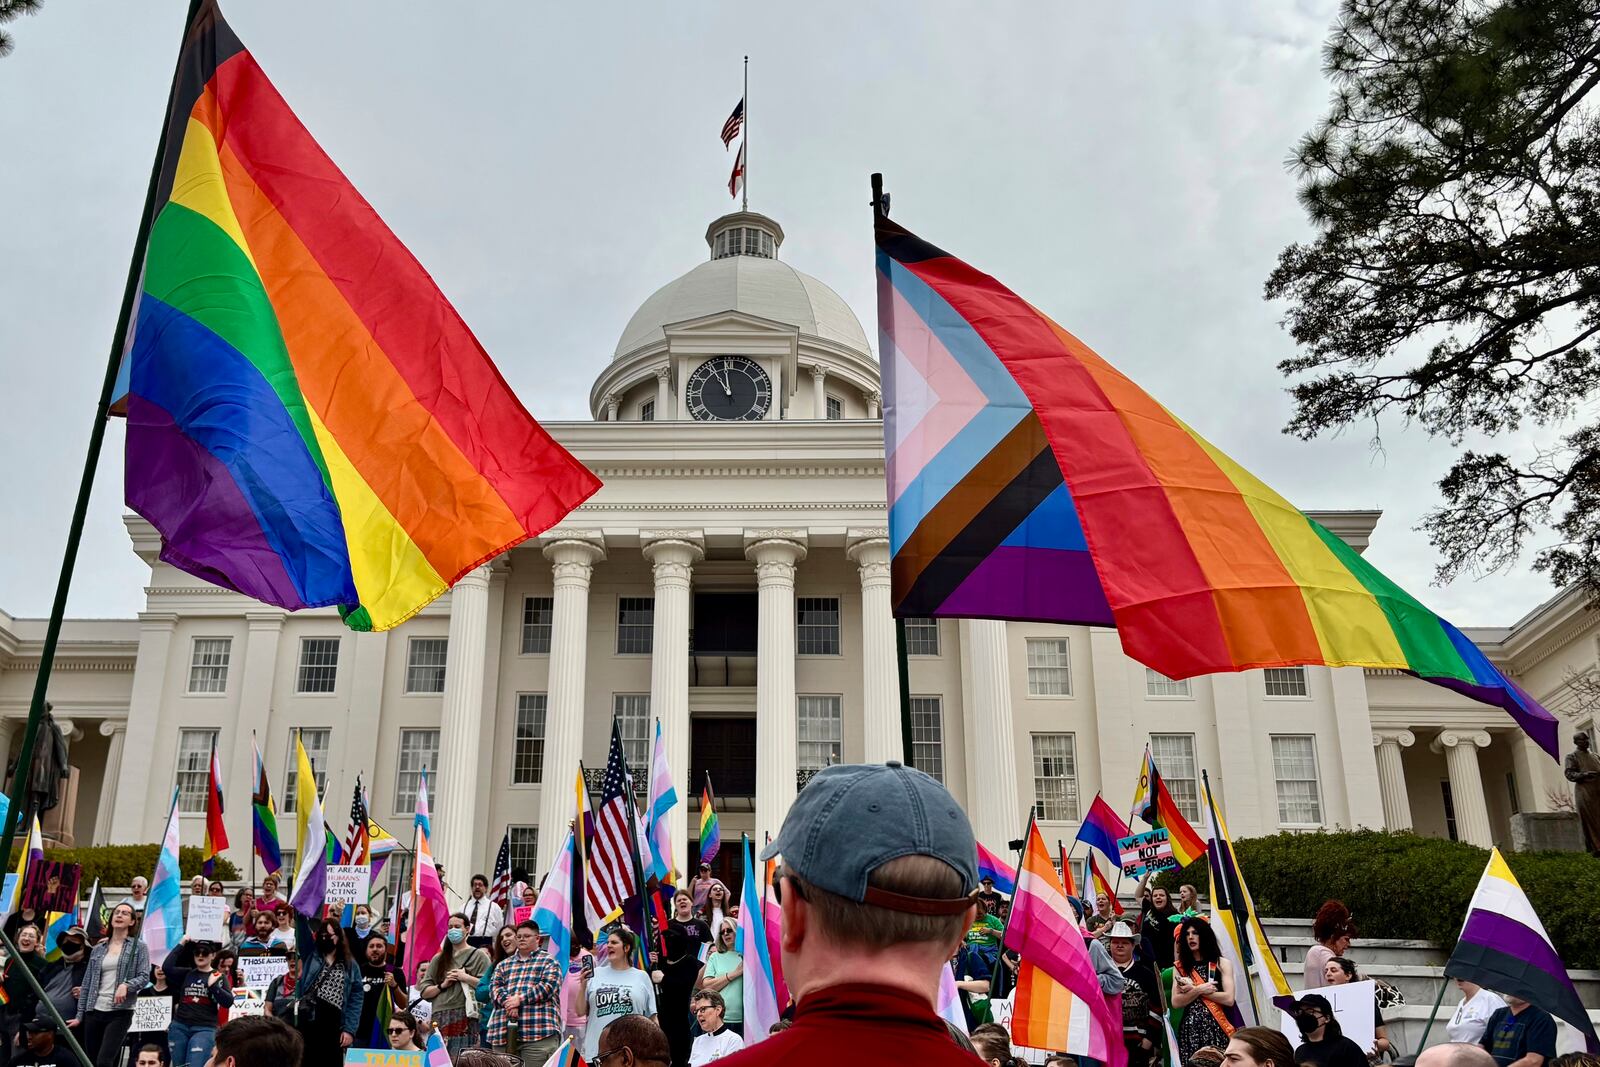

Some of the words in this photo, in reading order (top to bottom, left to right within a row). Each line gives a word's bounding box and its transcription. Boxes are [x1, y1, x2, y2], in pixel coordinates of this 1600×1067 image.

[1122, 838, 1140, 850] WE
[1144, 831, 1168, 845] WILL
[1138, 845, 1160, 859] NOT
[1124, 864, 1137, 876] BE
[1145, 856, 1175, 870] ERASED
[138, 998, 163, 1007] RANS
[596, 992, 618, 1006] LOVE
[136, 1020, 163, 1029] THREAT
[364, 1052, 421, 1067] TRANS
